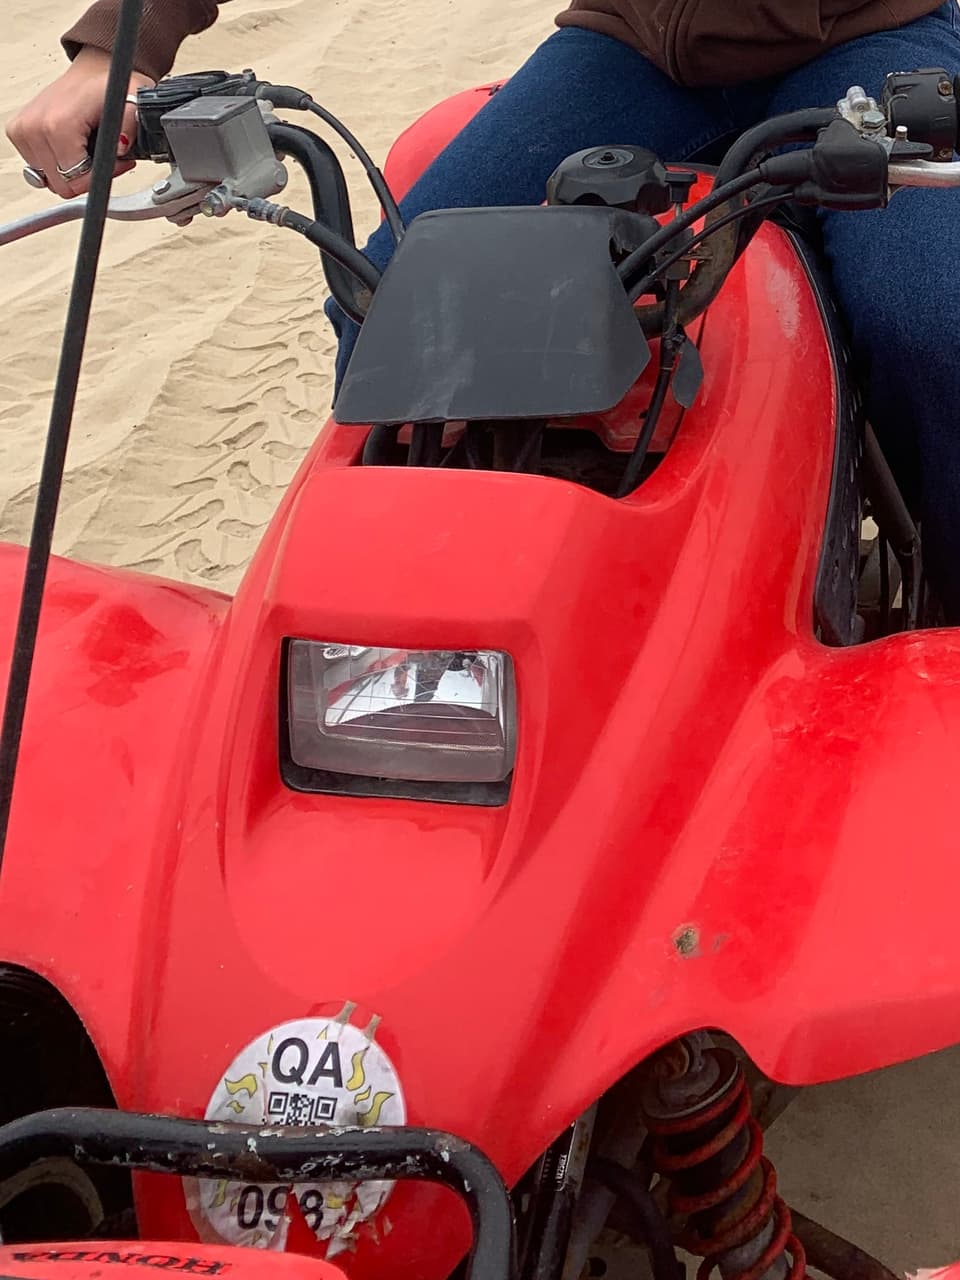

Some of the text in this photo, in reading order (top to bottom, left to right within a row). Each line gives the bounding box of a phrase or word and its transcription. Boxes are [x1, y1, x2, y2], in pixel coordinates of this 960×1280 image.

[271, 1037, 344, 1088] QA
[237, 1184, 324, 1232] 098
[12, 1250, 233, 1276] HONDA
